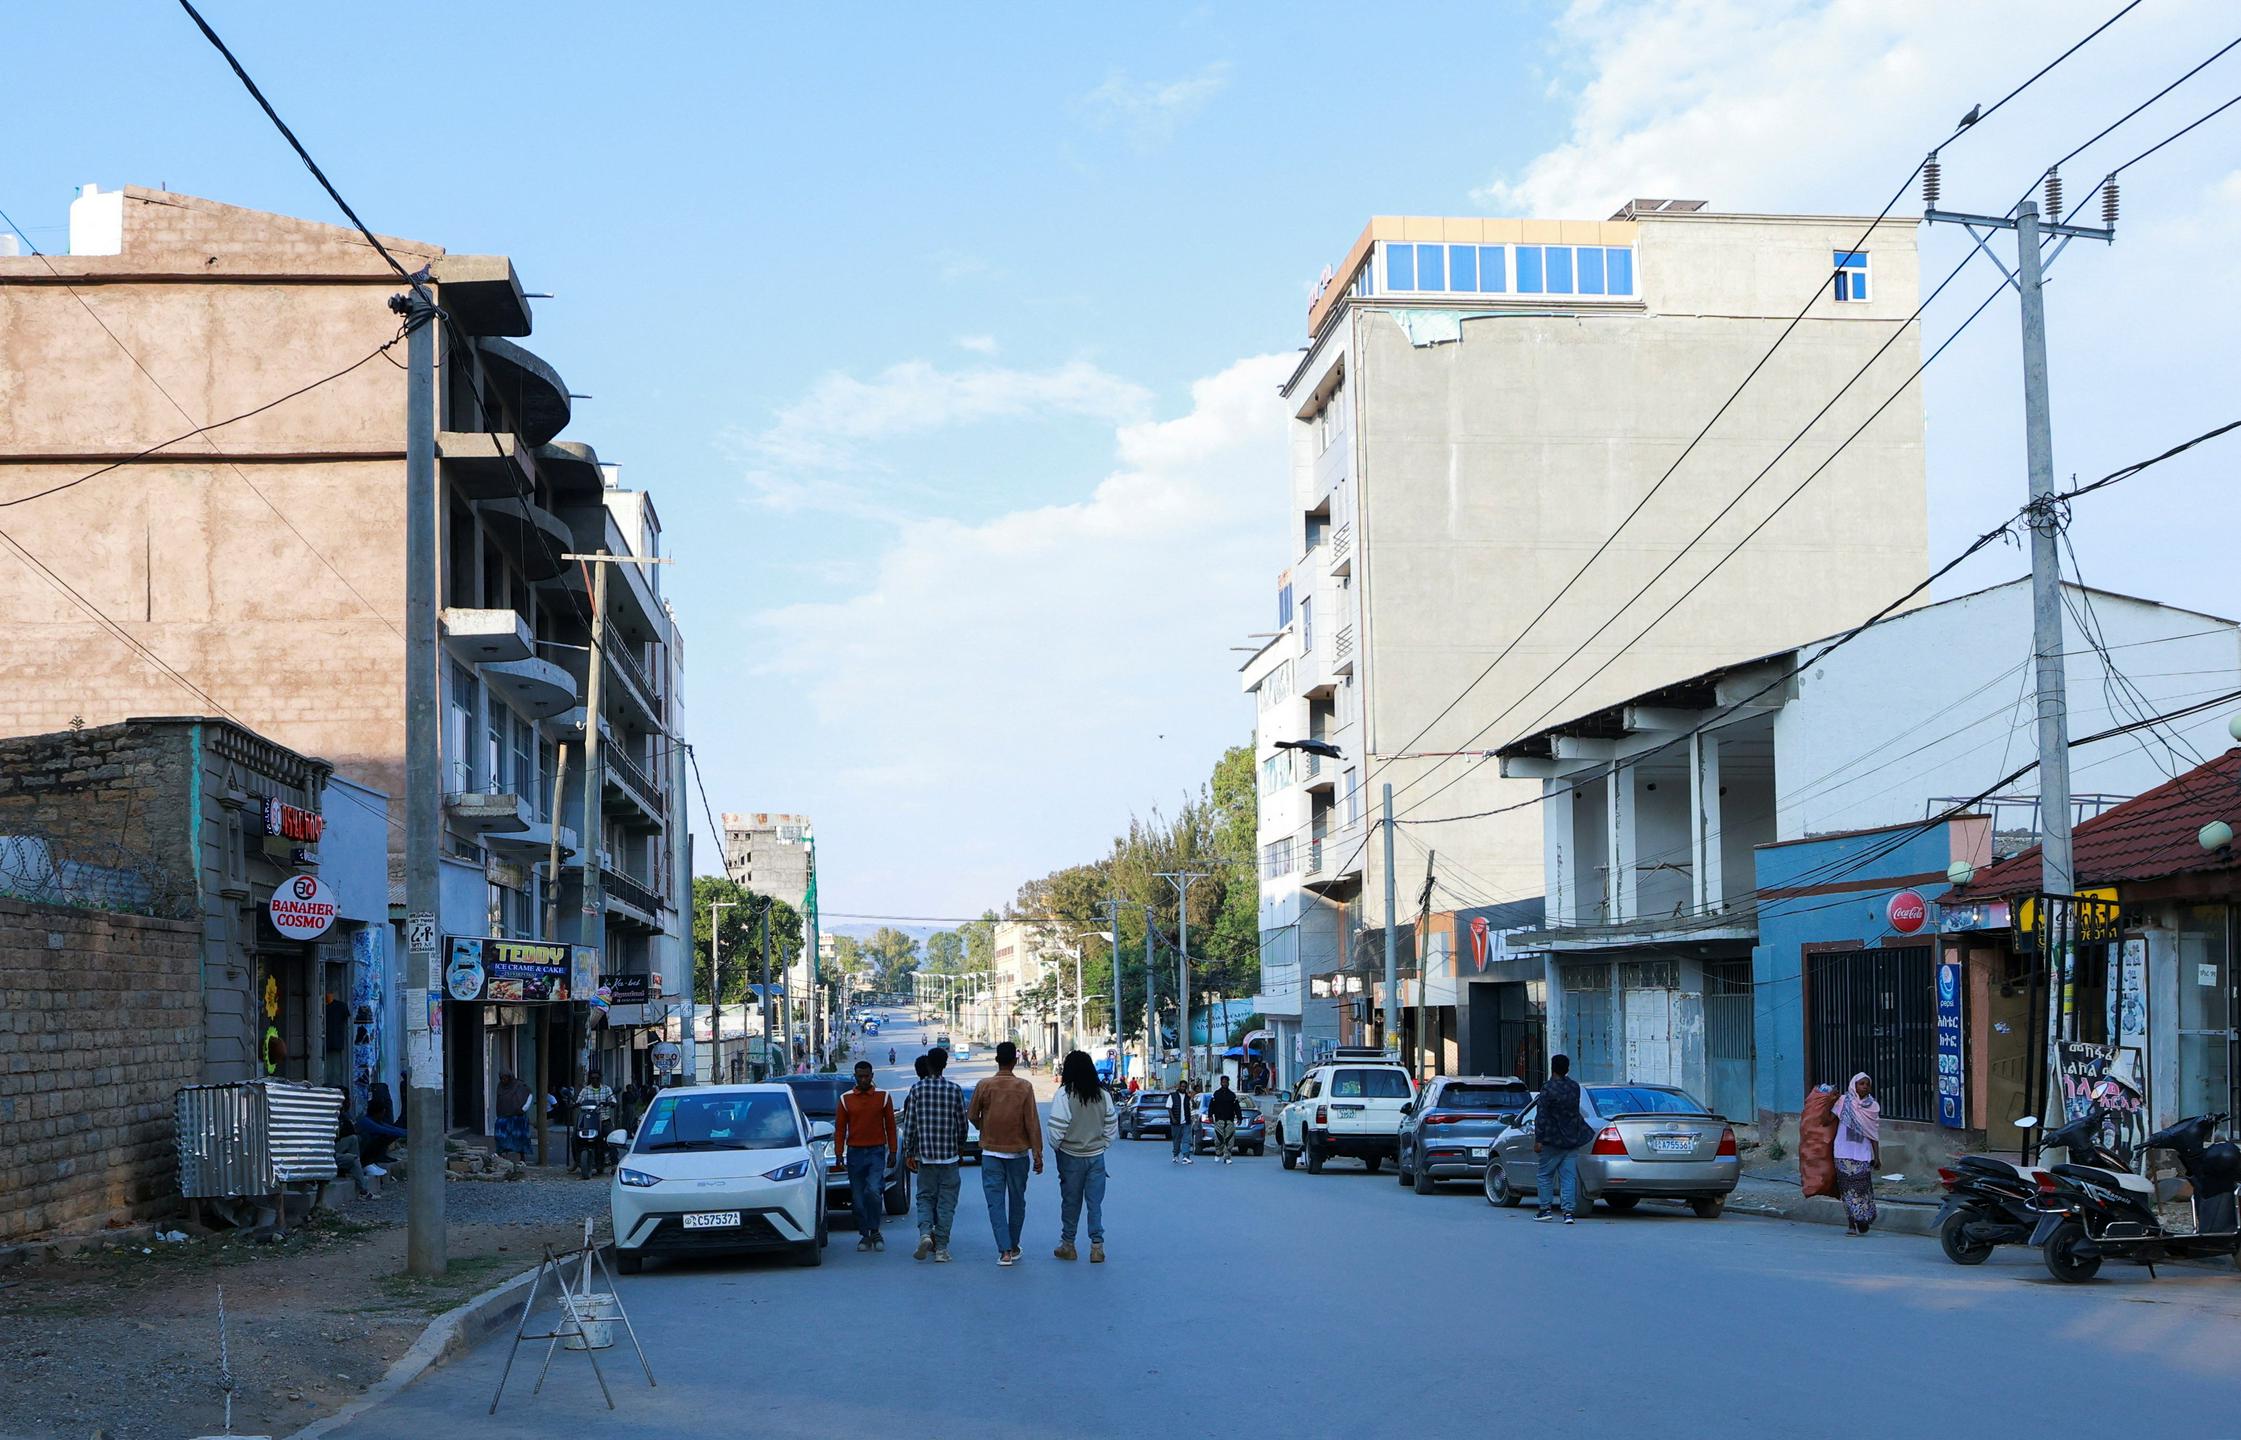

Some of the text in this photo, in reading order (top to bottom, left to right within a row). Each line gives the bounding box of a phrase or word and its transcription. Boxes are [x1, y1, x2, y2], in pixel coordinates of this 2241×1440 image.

[271, 900, 334, 916] BANAHER
[1893, 906, 1923, 920] Coca-Cola
[277, 914, 326, 929] COSMO
[495, 943, 565, 965] TEDDY
[494, 963, 507, 971] ICE
[508, 964, 535, 972] CRAME
[543, 966, 564, 974] CAKE
[1940, 1000, 1954, 1008] pepsi
[697, 1213, 733, 1226] C57537
